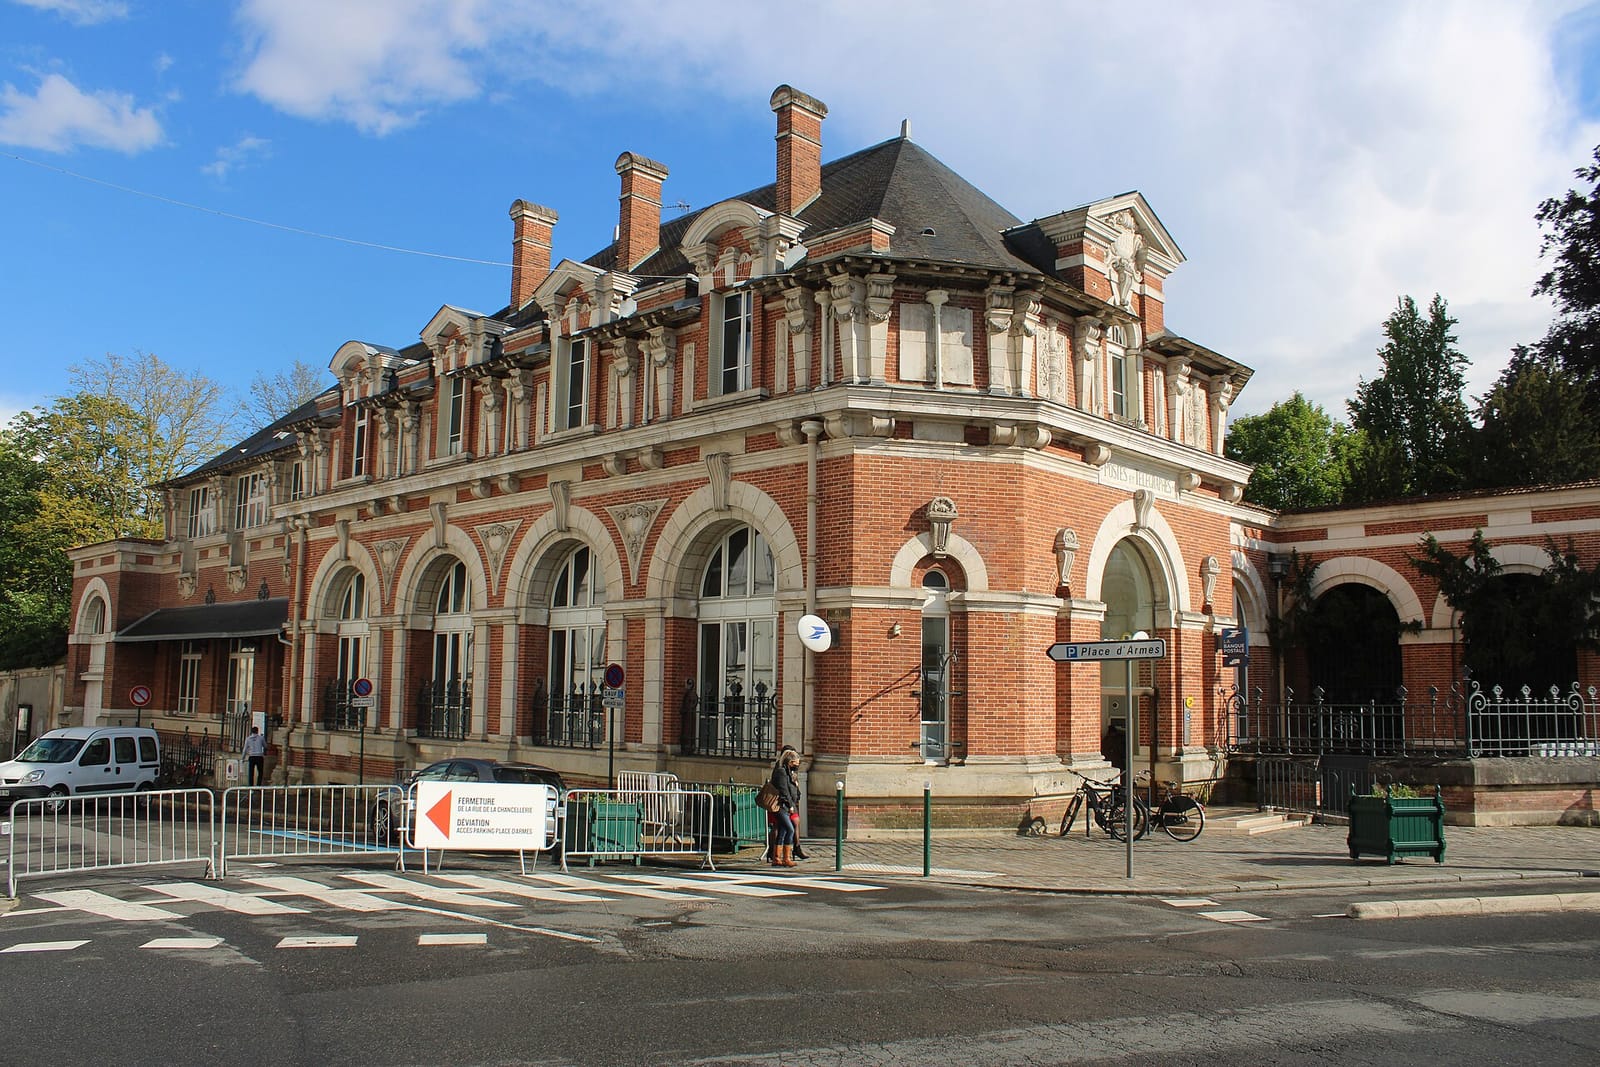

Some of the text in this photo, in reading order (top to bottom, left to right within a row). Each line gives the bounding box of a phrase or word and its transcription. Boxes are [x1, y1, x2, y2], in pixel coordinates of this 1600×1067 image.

[1067, 646, 1160, 657] P Place d'Armes
[458, 797, 495, 806] FERMETURE
